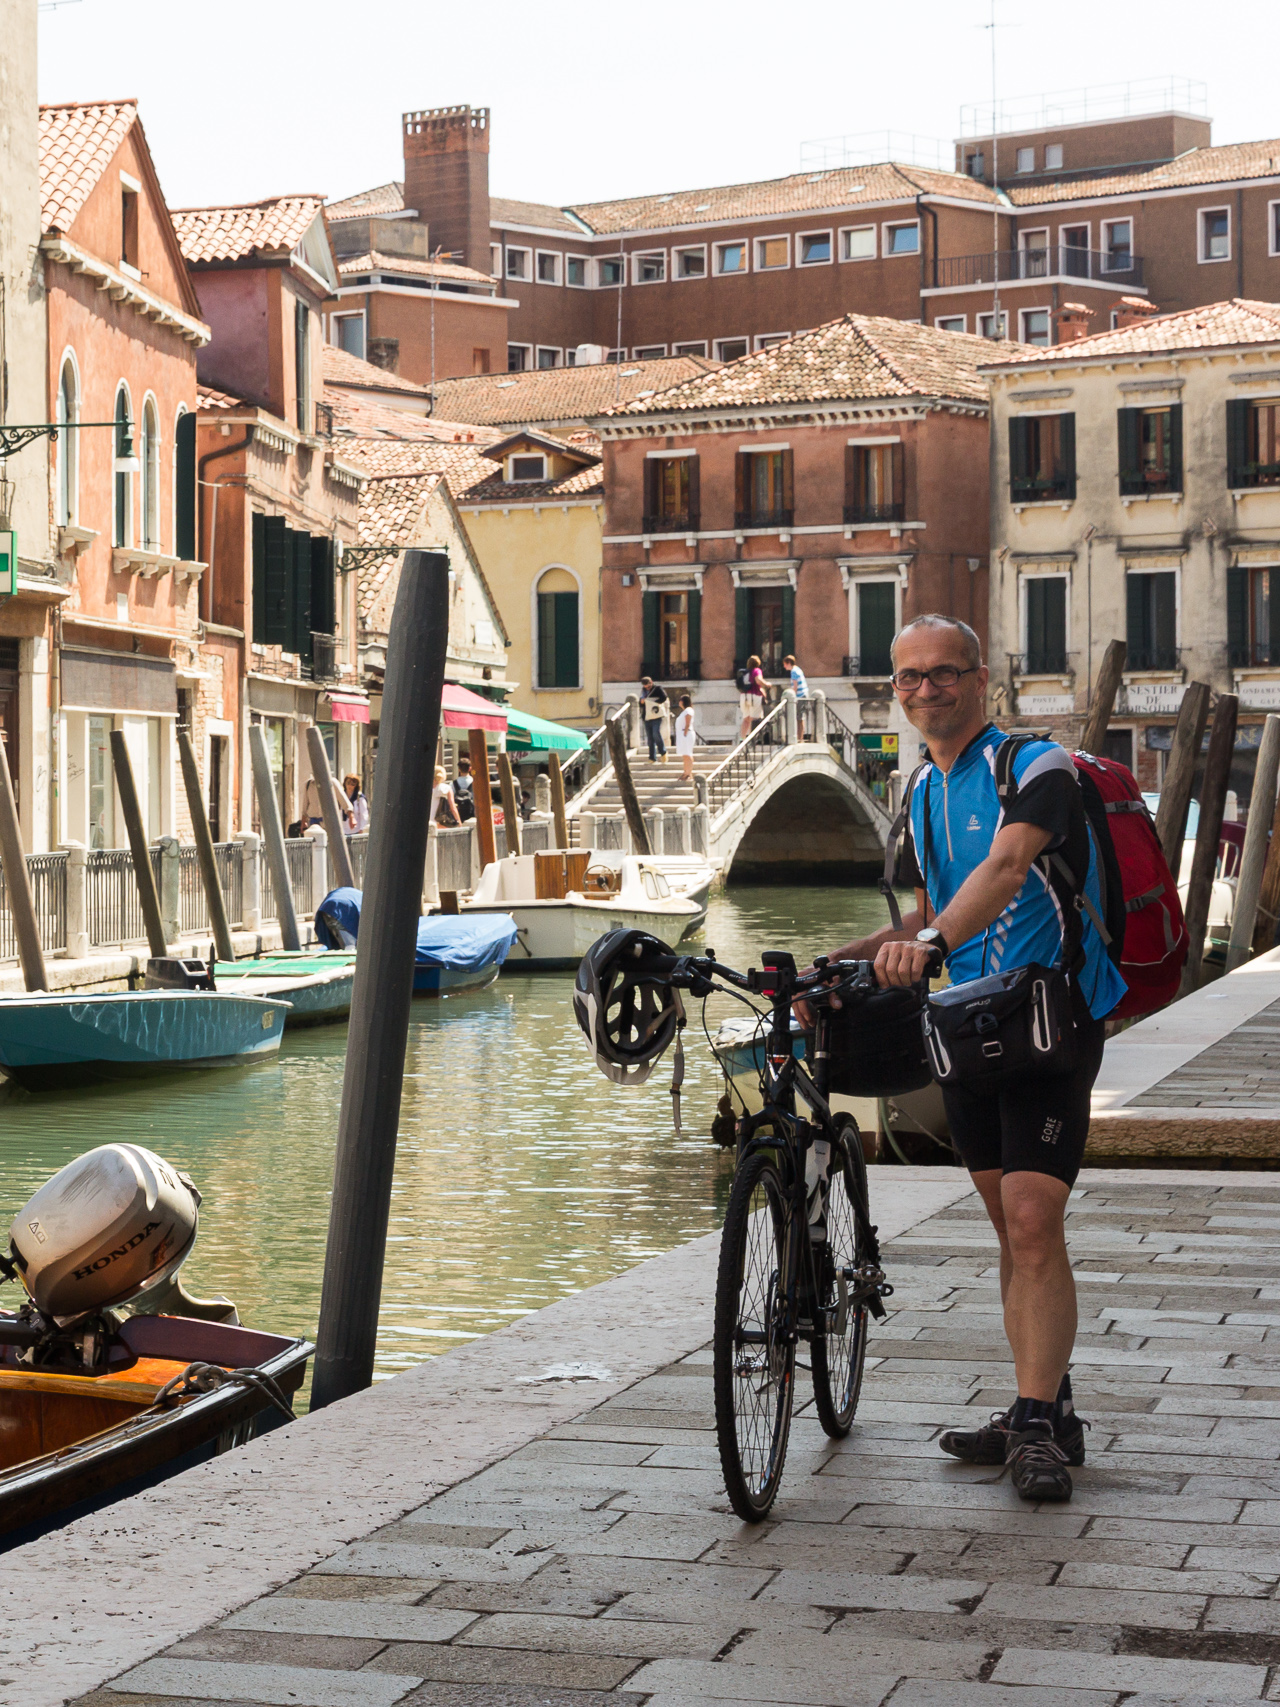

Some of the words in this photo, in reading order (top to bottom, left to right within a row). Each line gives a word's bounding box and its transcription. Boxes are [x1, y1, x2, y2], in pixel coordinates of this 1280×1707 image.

[1130, 685, 1178, 695] SESTIER
[1146, 696, 1161, 705] DE
[1041, 1116, 1057, 1142] GORE
[71, 1221, 162, 1281] HONDA
